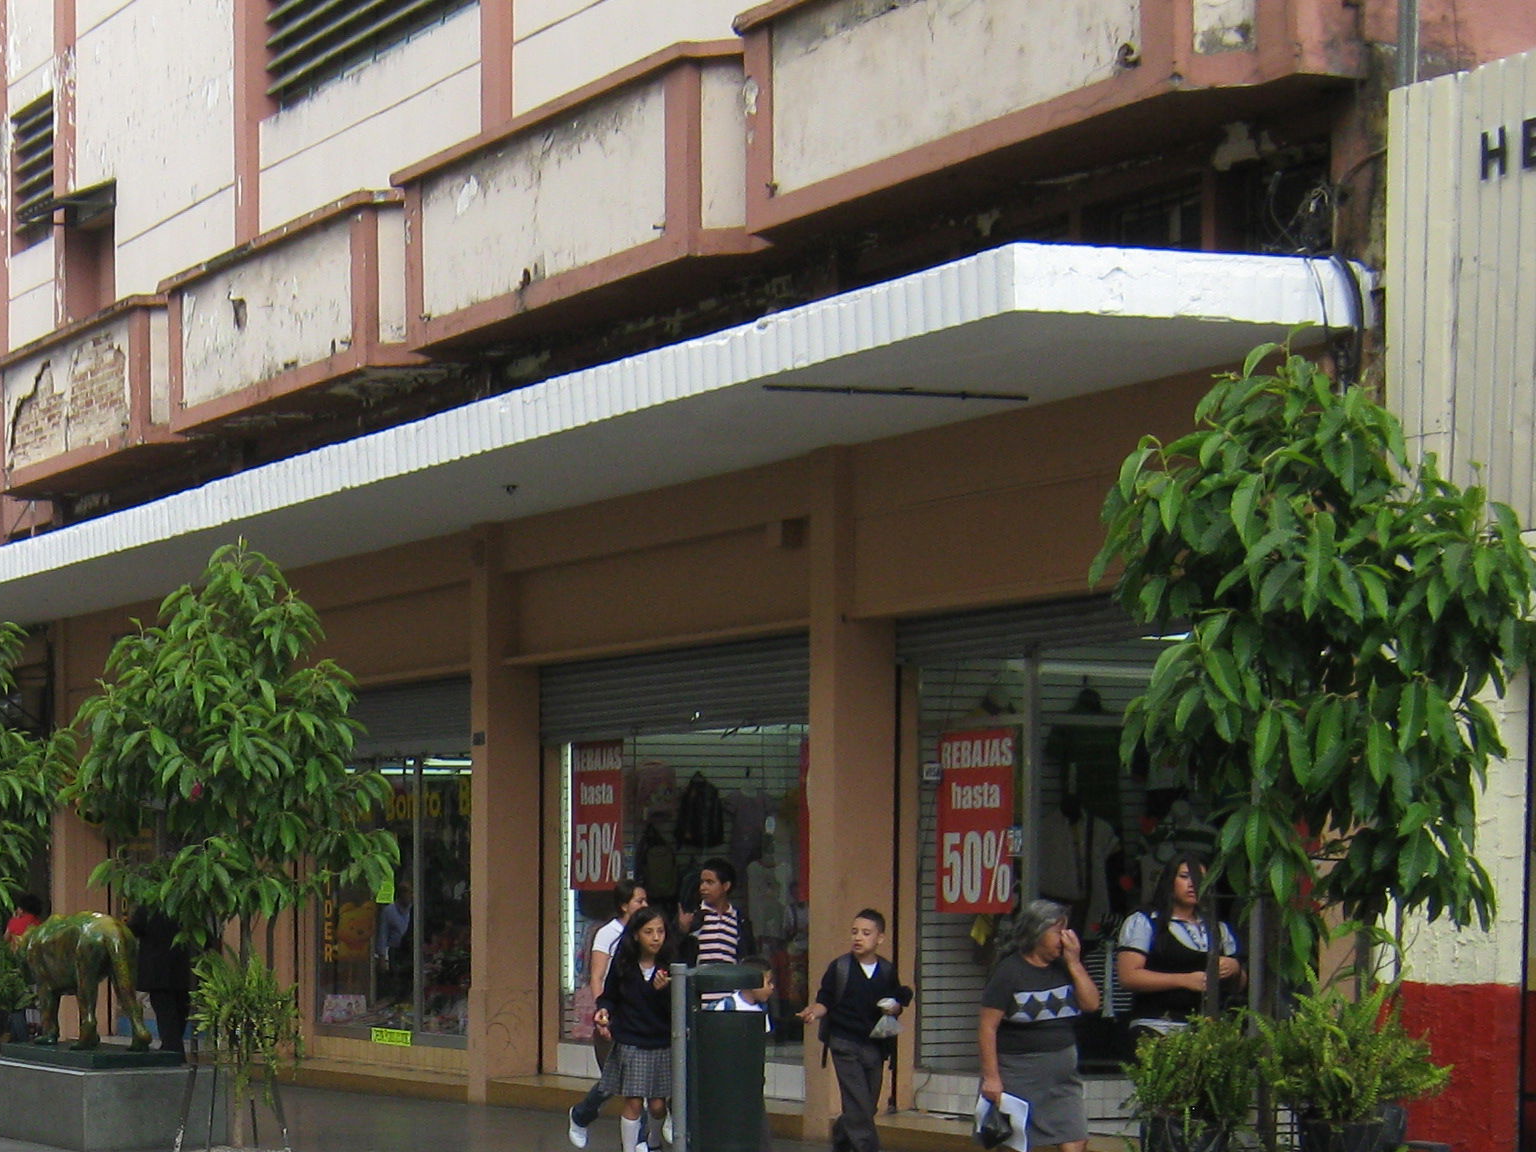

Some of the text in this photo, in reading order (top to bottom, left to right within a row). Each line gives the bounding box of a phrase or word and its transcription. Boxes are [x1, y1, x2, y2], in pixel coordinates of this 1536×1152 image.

[574, 746, 623, 773] REBAJAS
[941, 736, 1013, 769] REBAJAS
[579, 781, 614, 806] hasta
[951, 781, 1001, 810] hasta
[574, 822, 622, 884] 50%
[941, 829, 1011, 904] 50%
